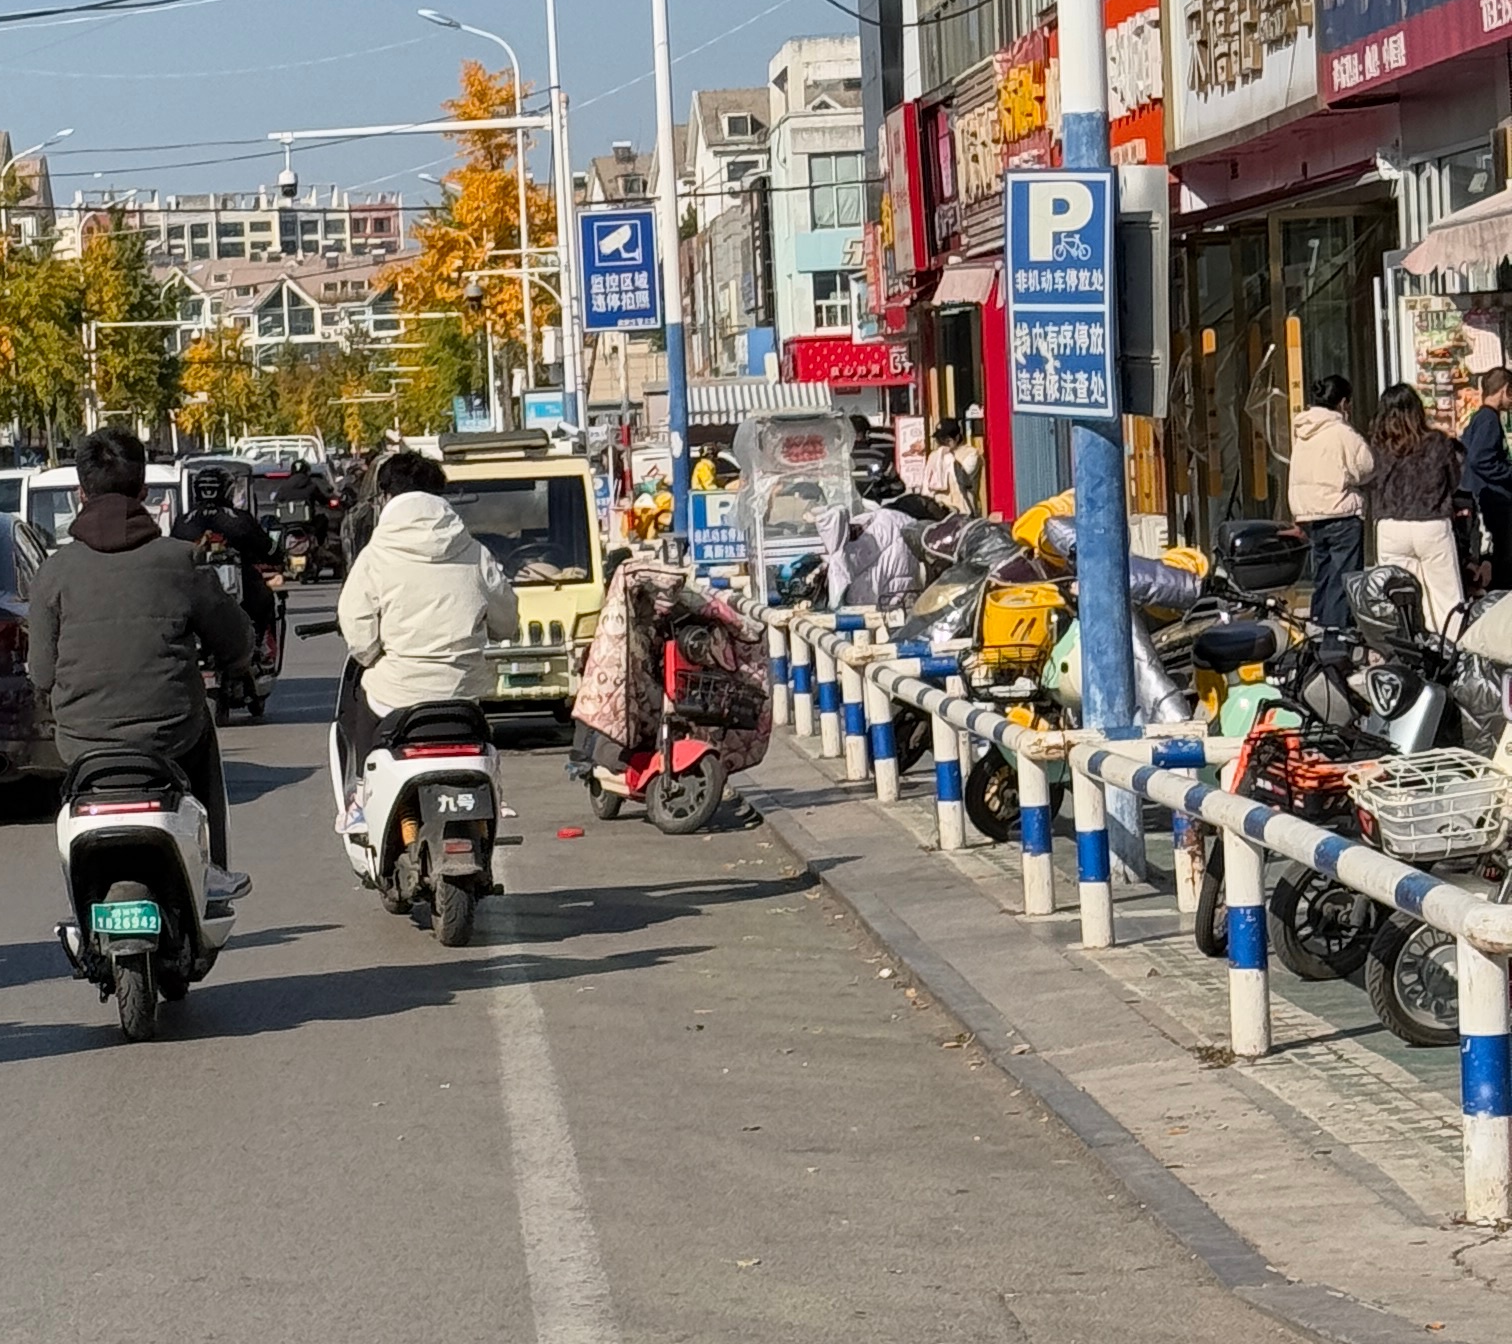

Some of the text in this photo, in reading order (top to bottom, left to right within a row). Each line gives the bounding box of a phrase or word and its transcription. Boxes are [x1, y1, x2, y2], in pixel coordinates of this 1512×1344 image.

[1029, 182, 1093, 261] P
[591, 271, 649, 293] 监控区域
[1015, 268, 1104, 293] 非机动车停放处
[592, 290, 650, 313] 违停拍照
[706, 494, 736, 527] P
[438, 792, 476, 813] 九号
